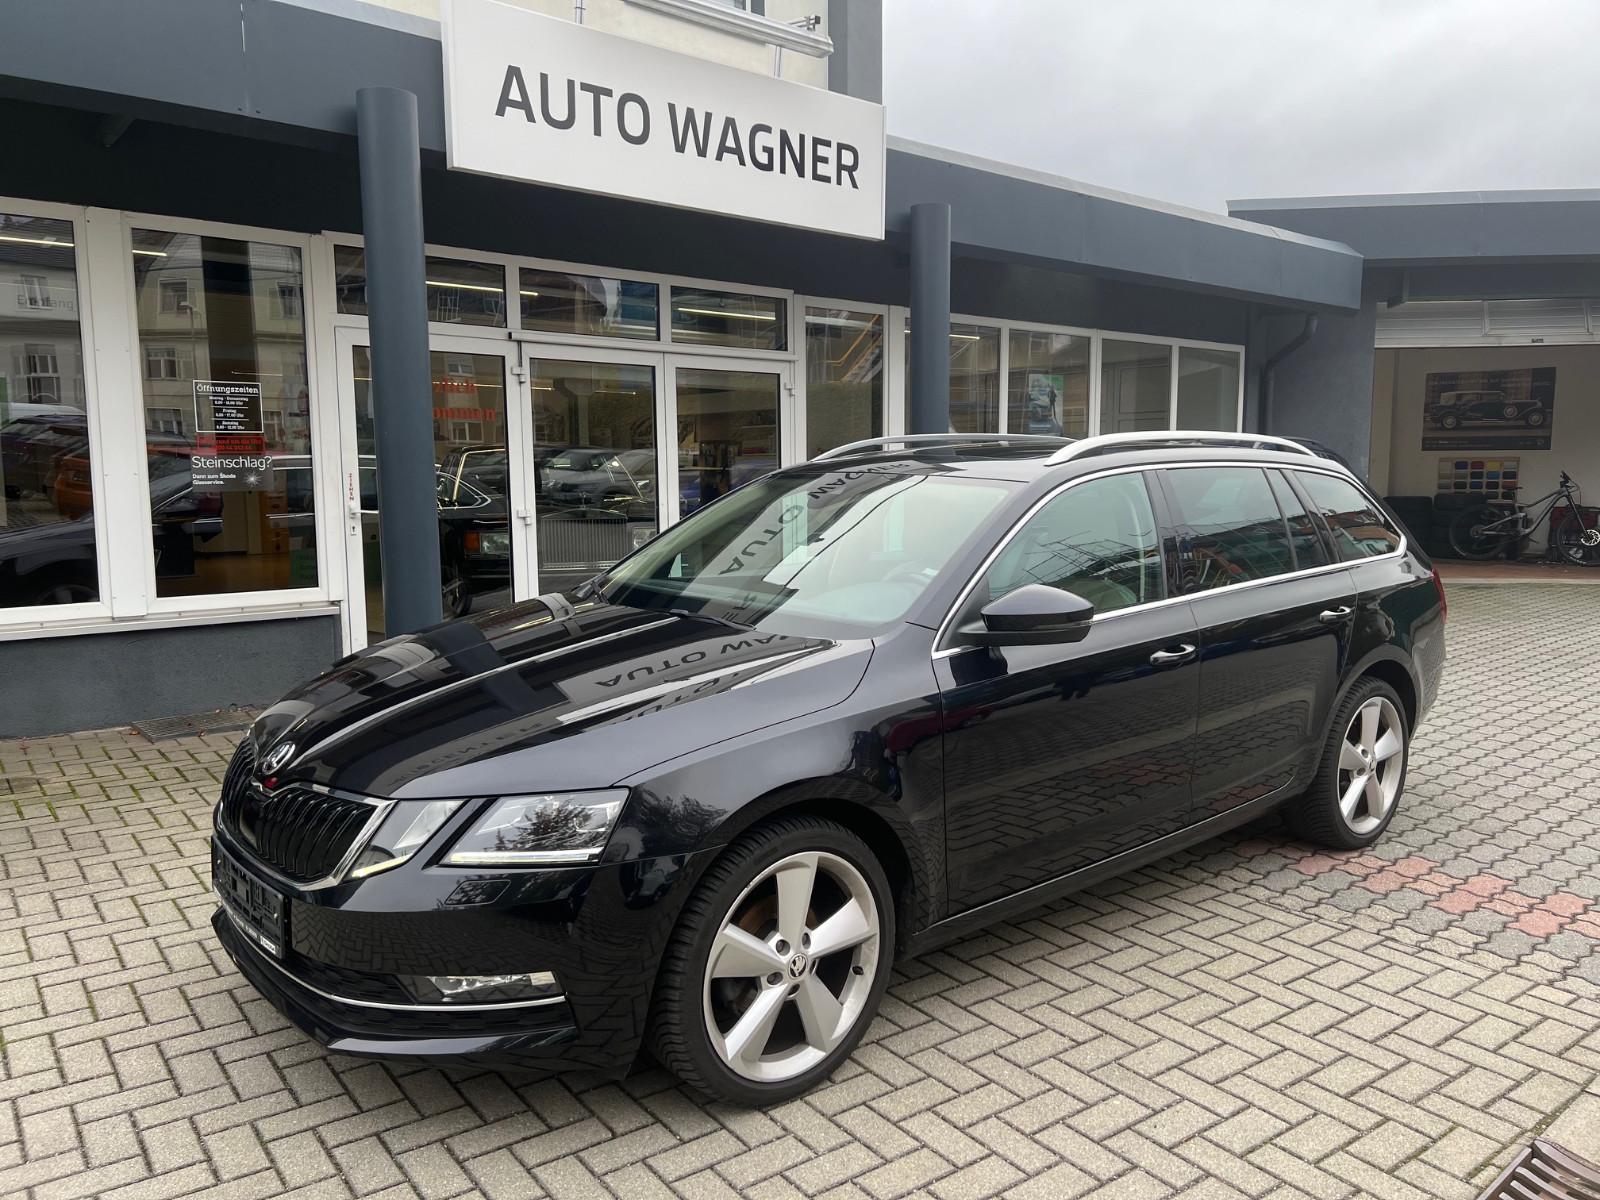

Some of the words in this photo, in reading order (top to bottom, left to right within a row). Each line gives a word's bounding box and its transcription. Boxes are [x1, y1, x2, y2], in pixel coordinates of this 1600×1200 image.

[495, 64, 651, 146] AUTO
[667, 102, 860, 190] WAGNER
[196, 384, 259, 394] Öffnungszeiten
[191, 455, 273, 471] Steinschlag?
